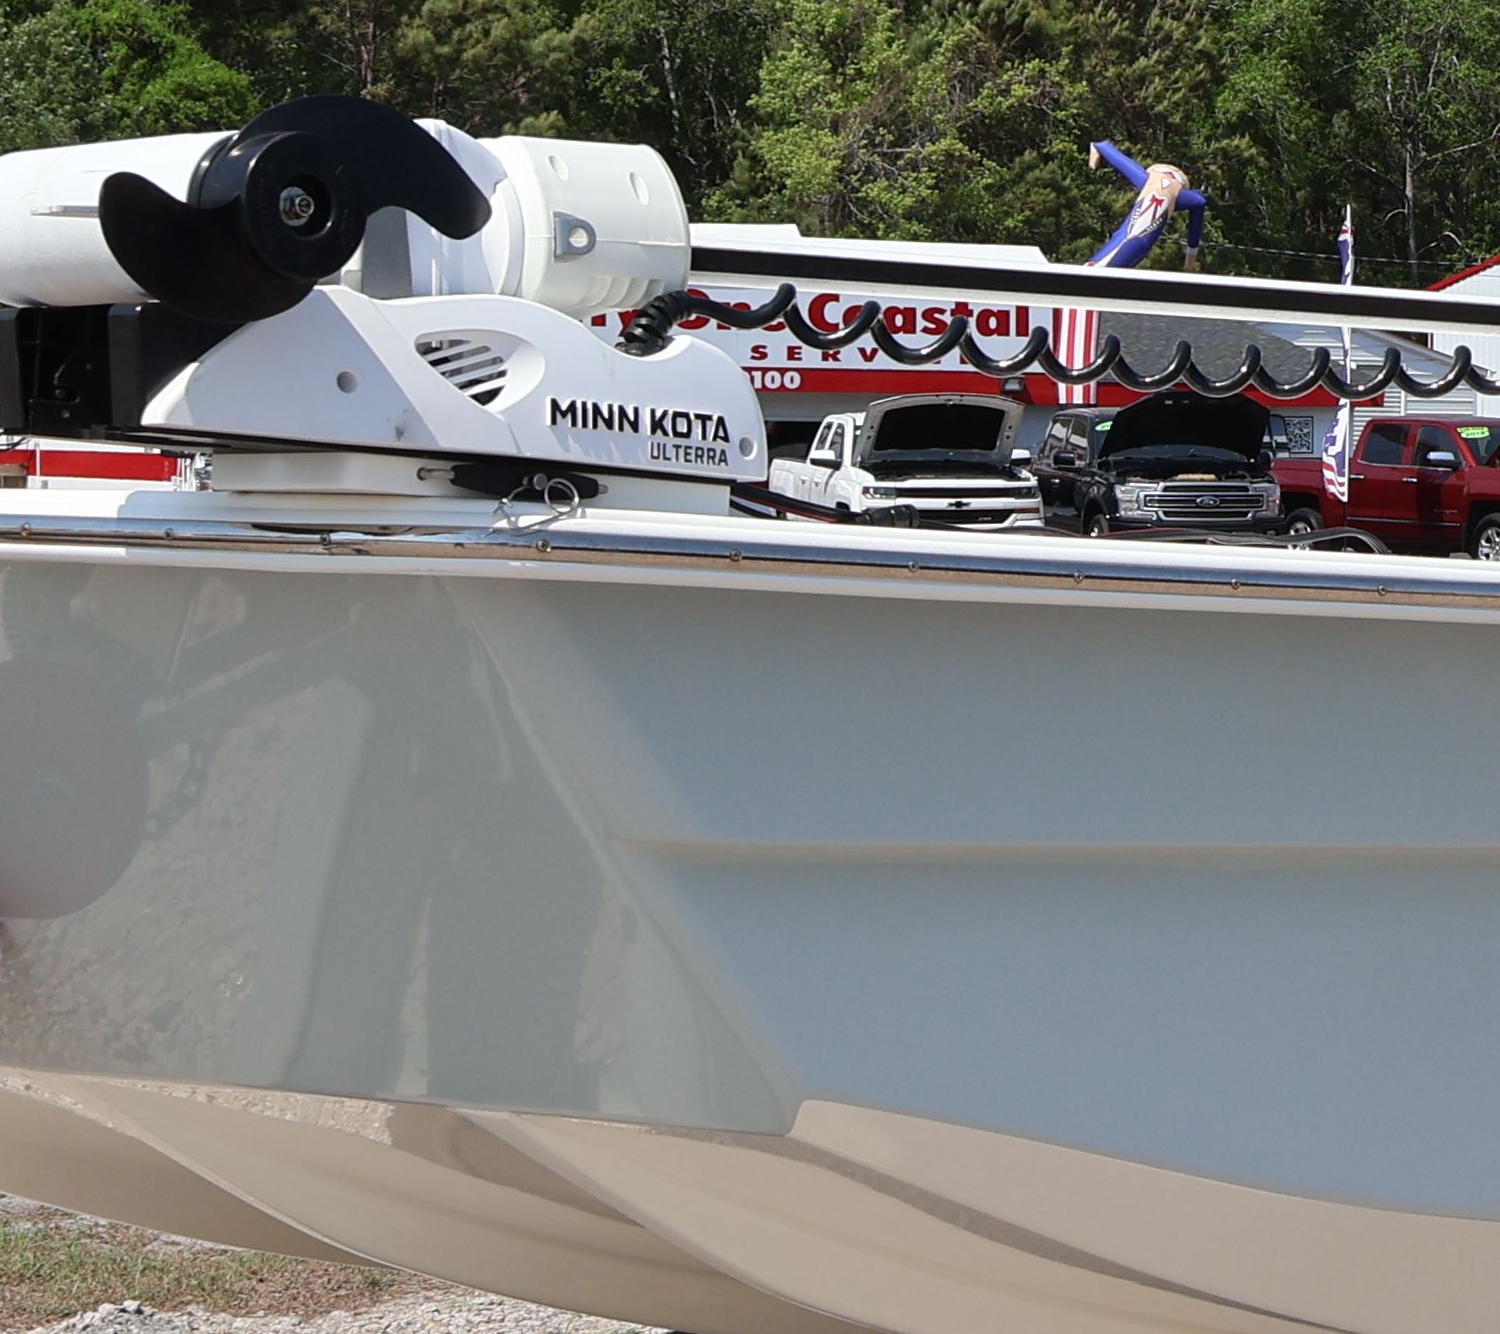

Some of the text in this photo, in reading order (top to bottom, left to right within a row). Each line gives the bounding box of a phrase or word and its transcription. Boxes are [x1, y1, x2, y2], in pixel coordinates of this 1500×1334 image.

[549, 397, 730, 443] MINN KOTA
[650, 442, 729, 466] ULTERRA
